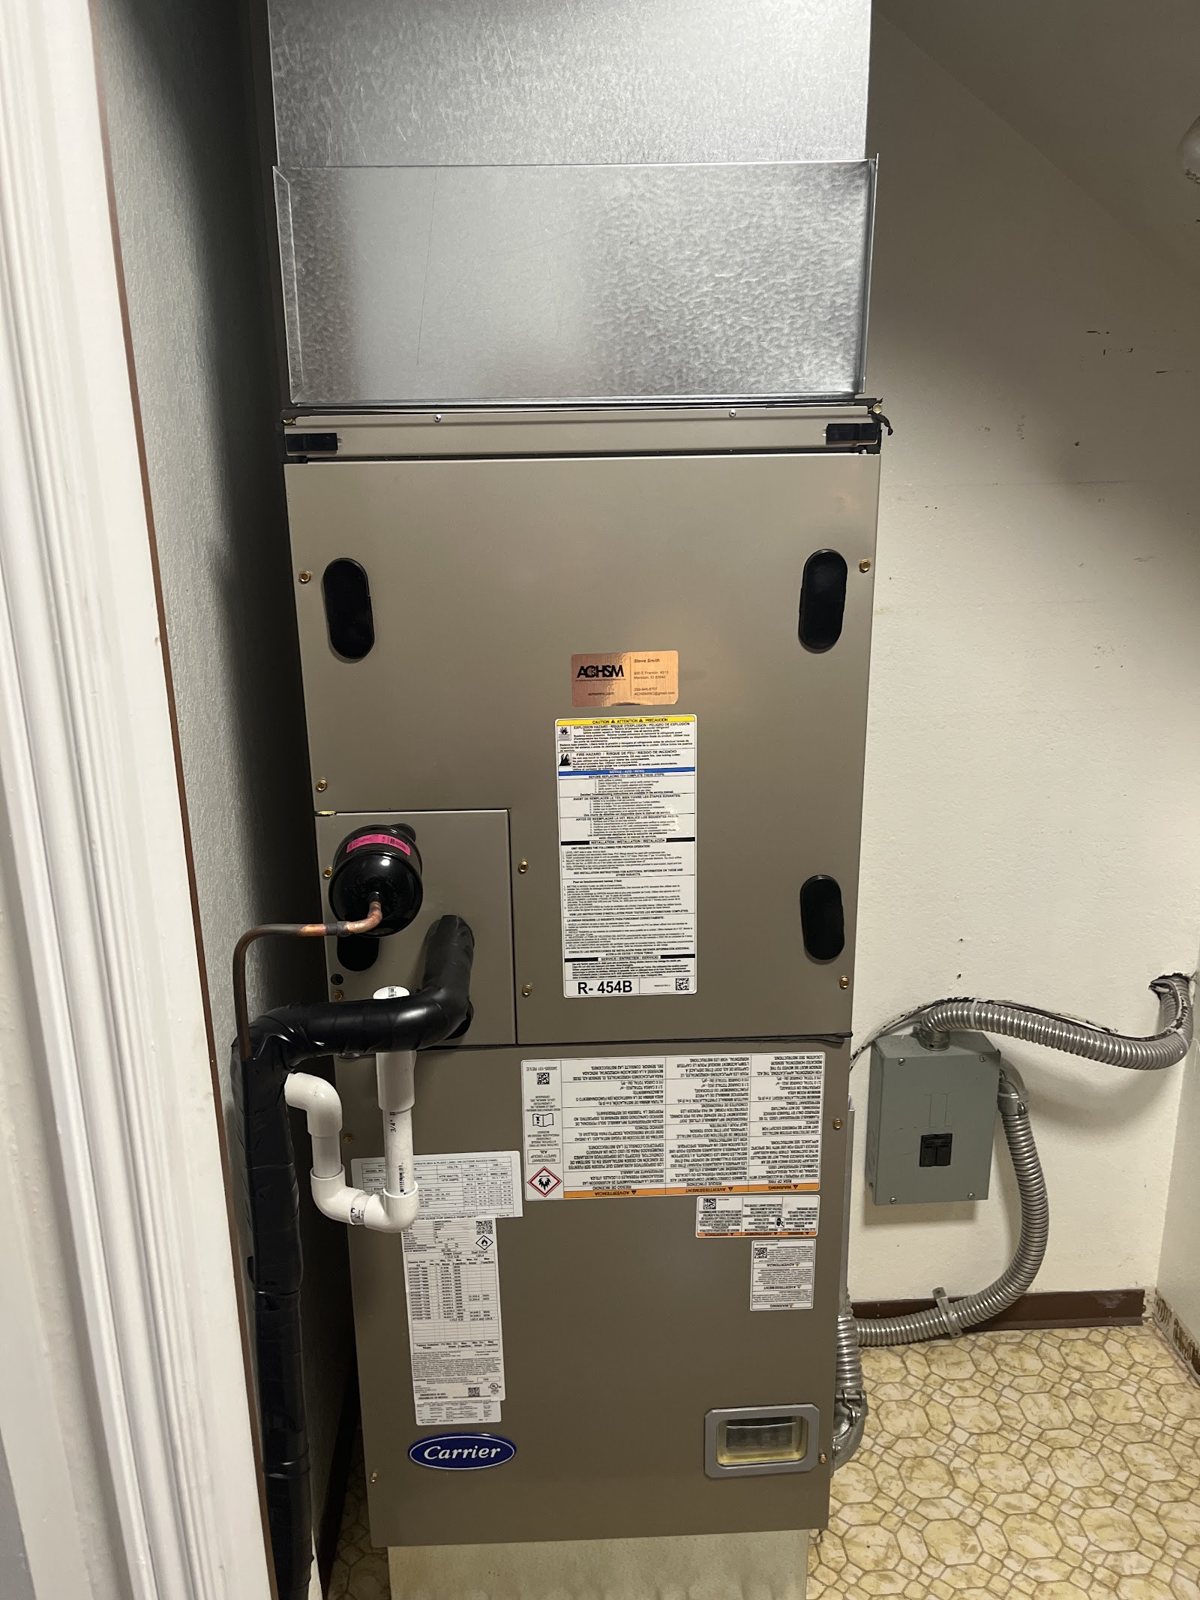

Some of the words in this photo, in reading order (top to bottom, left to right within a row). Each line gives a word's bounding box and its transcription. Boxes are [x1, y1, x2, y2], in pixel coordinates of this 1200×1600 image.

[578, 982, 593, 994] R-
[597, 981, 632, 993] 454B
[424, 1446, 501, 1459] Carrier
